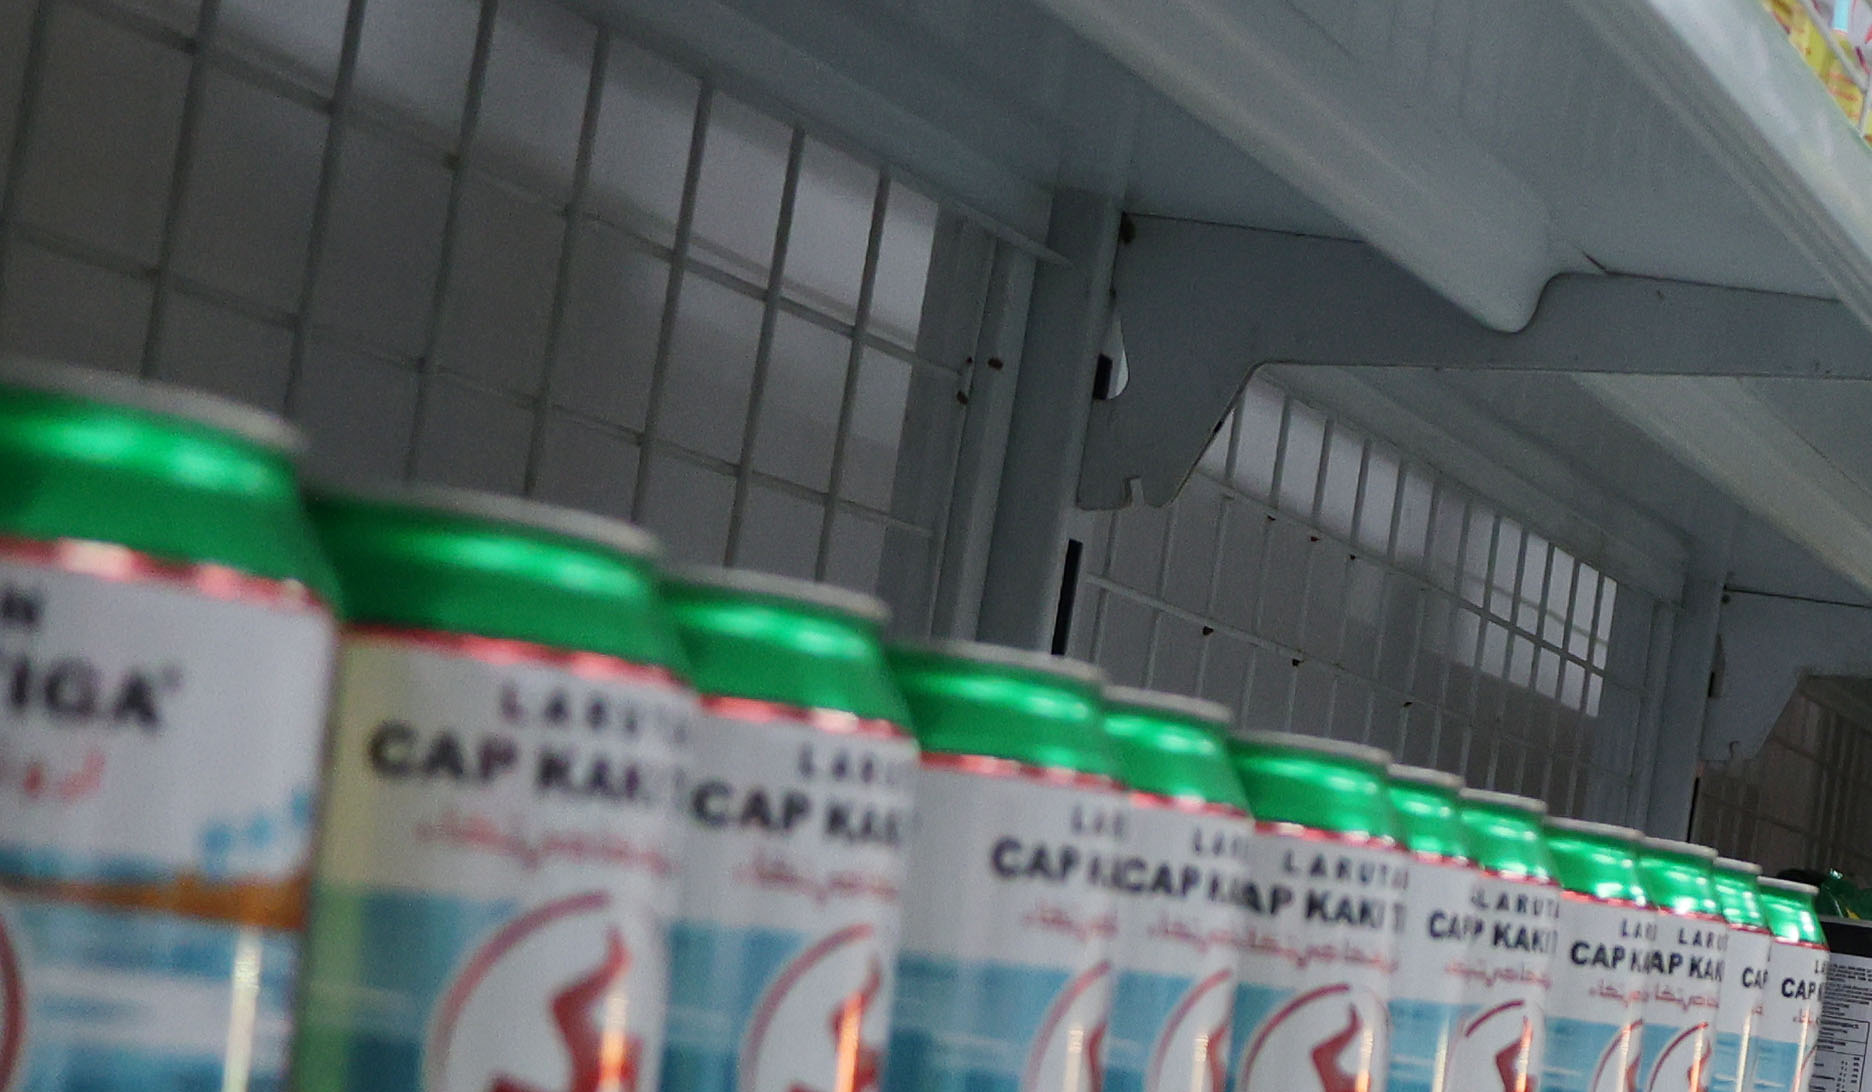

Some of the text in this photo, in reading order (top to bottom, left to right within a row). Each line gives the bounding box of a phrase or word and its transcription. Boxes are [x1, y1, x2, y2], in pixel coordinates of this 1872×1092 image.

[366, 718, 522, 797] CAP
[690, 778, 810, 836] CAP
[990, 836, 1080, 883] CAP
[1570, 940, 1626, 971] CAP
[1781, 977, 1818, 1001] CAP
